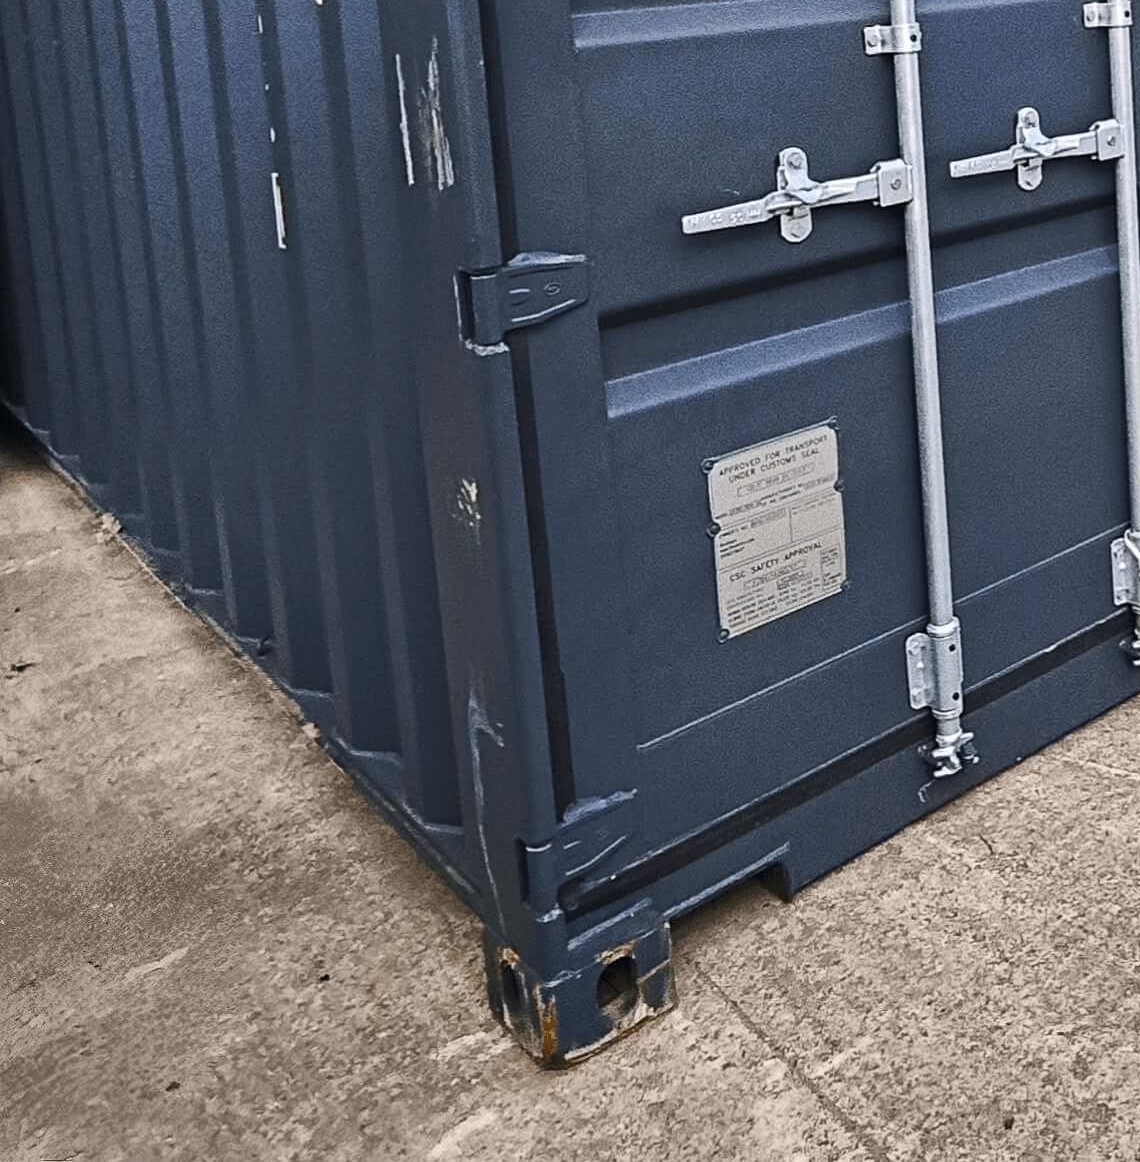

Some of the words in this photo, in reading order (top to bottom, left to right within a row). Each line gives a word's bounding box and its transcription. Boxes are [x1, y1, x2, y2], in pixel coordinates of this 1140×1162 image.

[719, 457, 761, 477] APPROVED
[765, 450, 781, 462] FOR
[785, 434, 829, 455] TRANSPORT
[728, 468, 756, 484] UNDER
[760, 454, 797, 473] CUSTOMS
[801, 447, 820, 460] SEAL
[729, 570, 747, 583] CSC
[750, 557, 779, 575] SAFETY
[785, 541, 823, 560] APPROVAL
